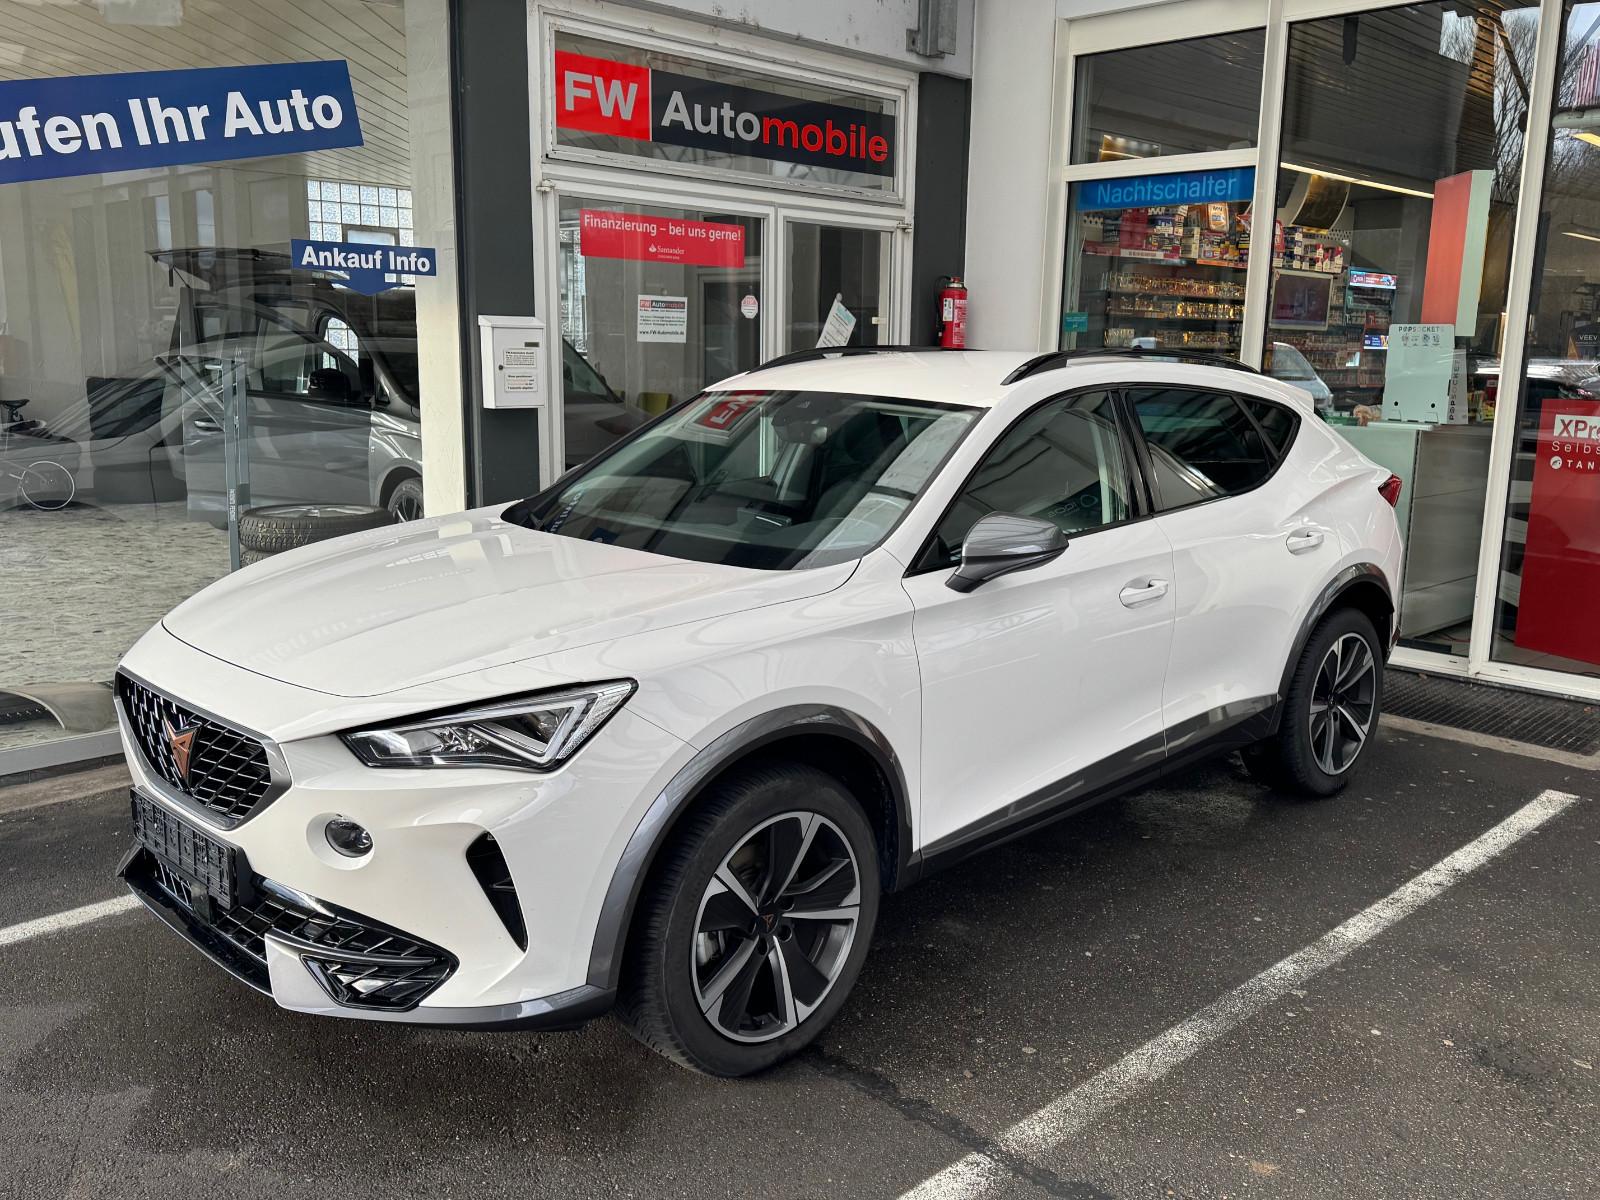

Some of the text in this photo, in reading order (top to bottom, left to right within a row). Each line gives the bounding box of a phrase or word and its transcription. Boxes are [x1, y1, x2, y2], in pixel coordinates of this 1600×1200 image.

[0, 89, 343, 159] ufen Ihr Auto
[564, 70, 888, 162] FW Automobile
[1097, 175, 1238, 205] Nachtschalter
[584, 214, 657, 236] Finanzierung
[669, 222, 685, 236] bei
[688, 227, 706, 238] uns
[709, 229, 741, 242] gerne!
[301, 246, 430, 272] Ankauf Info
[657, 245, 685, 255] Santander
[1551, 440, 1600, 455] Selbs
[1567, 459, 1600, 471] TAN
